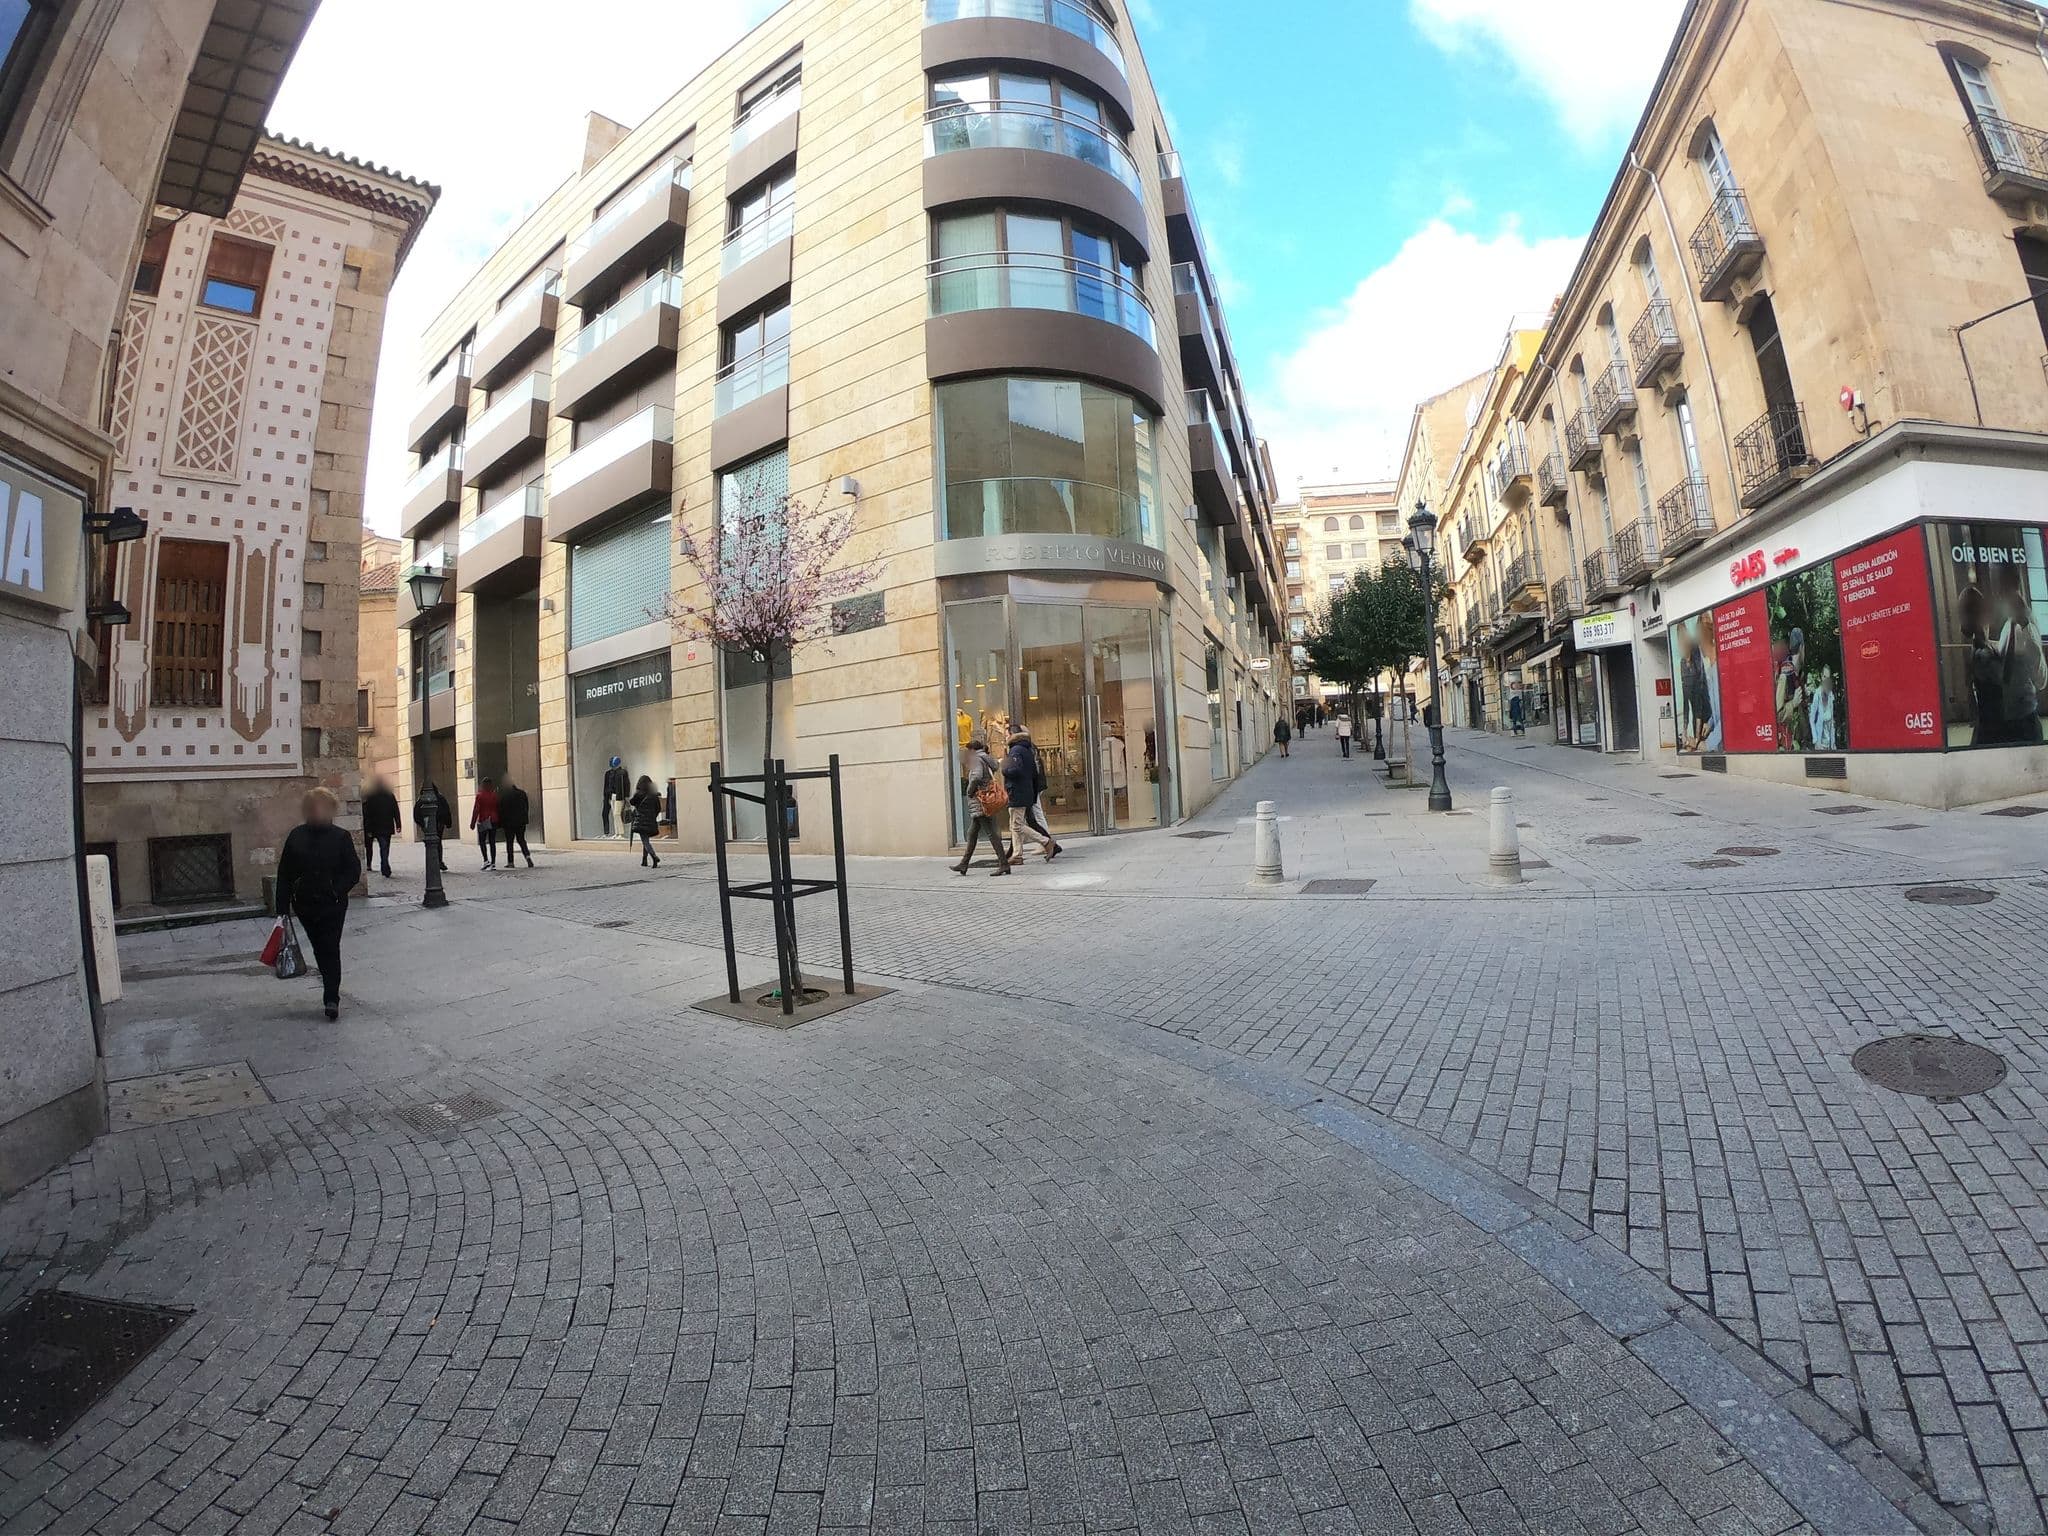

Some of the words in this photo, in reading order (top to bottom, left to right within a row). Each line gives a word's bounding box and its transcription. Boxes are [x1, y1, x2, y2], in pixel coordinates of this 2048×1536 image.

[985, 543, 1099, 562] ROBERTO
[1106, 546, 1165, 572] VERINO
[1951, 542, 1977, 563] OÍR
[1979, 546, 2009, 563] BIEN
[2011, 548, 2027, 564] ES
[1730, 549, 1766, 587] GAES
[1840, 569, 1852, 579] UNA
[1852, 560, 1871, 574] BUENA
[1842, 581, 1849, 591] ES
[1867, 572, 1874, 582] DE
[1874, 566, 1893, 580] SALUD
[586, 680, 624, 700] ROBERTO
[627, 672, 663, 691] VERINO
[1755, 724, 1773, 737] GAES
[1905, 711, 1934, 729] GAES
